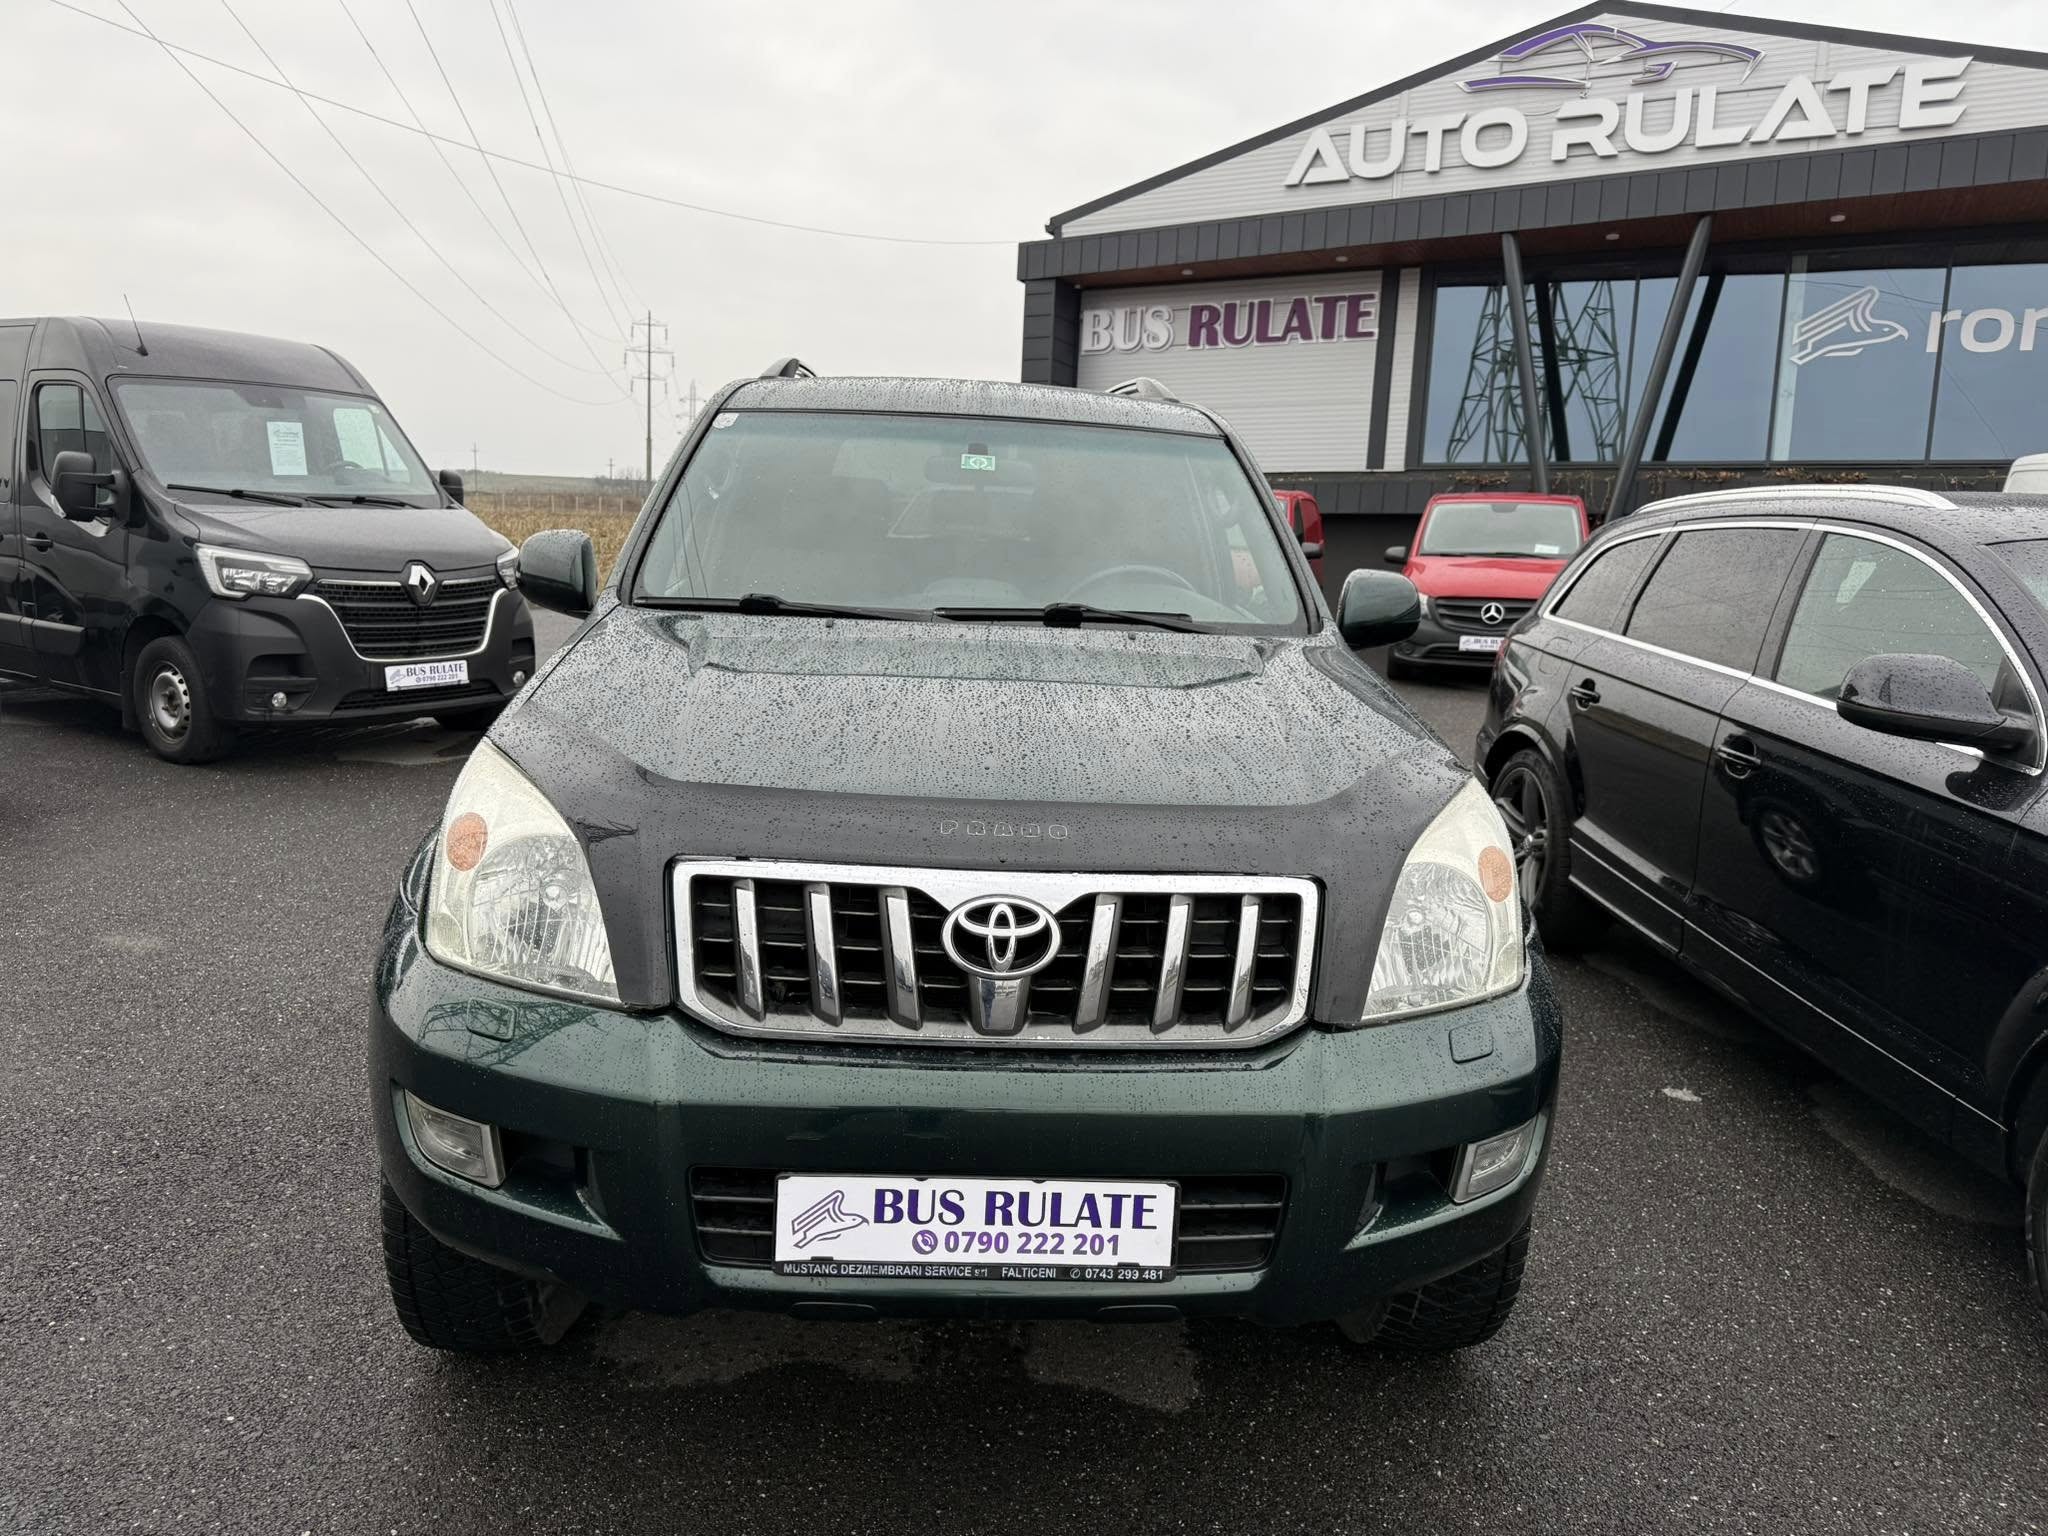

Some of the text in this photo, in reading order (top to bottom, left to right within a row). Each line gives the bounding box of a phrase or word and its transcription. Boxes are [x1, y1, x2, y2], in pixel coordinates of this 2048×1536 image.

[1284, 56, 1974, 187] AUTO RULATE
[1081, 291, 1382, 354] BUS RULATE
[406, 663, 465, 677] BUS RULATE
[940, 819, 1068, 840] PRADO
[873, 1188, 1157, 1229] BUS RULATE
[944, 1230, 1119, 1256] 0790 222 201
[783, 1263, 838, 1275] MUSTANG
[840, 1264, 922, 1276] DEZMEMBRARI
[924, 1266, 972, 1277] SERVICE
[1002, 1267, 1056, 1279] FALTICENI
[1085, 1268, 1114, 1279] 0743
[1117, 1268, 1139, 1280] 299
[1142, 1269, 1163, 1280] 481
